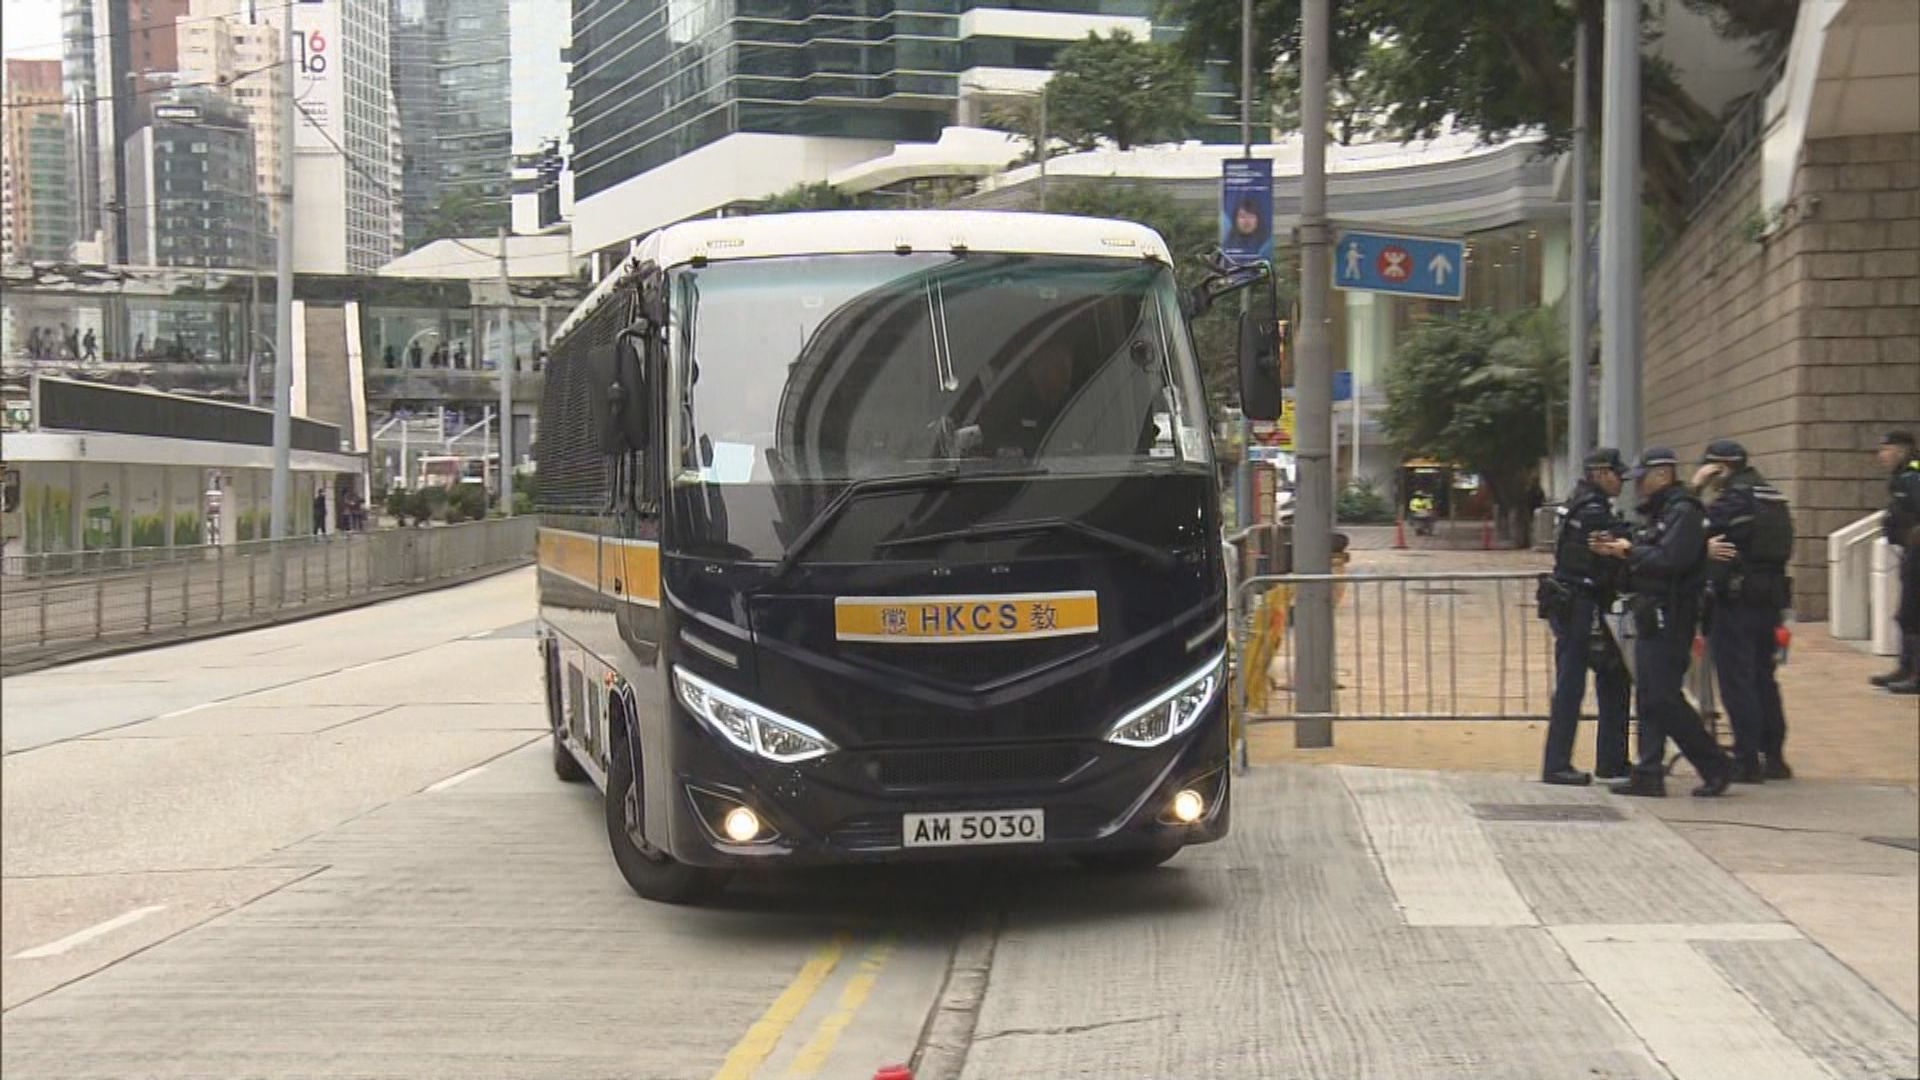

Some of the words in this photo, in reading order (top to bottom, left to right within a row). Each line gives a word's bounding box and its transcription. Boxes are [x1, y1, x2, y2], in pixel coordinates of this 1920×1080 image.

[921, 603, 1018, 631] HKCS
[914, 817, 951, 841] AM
[961, 815, 1035, 839] 5030
